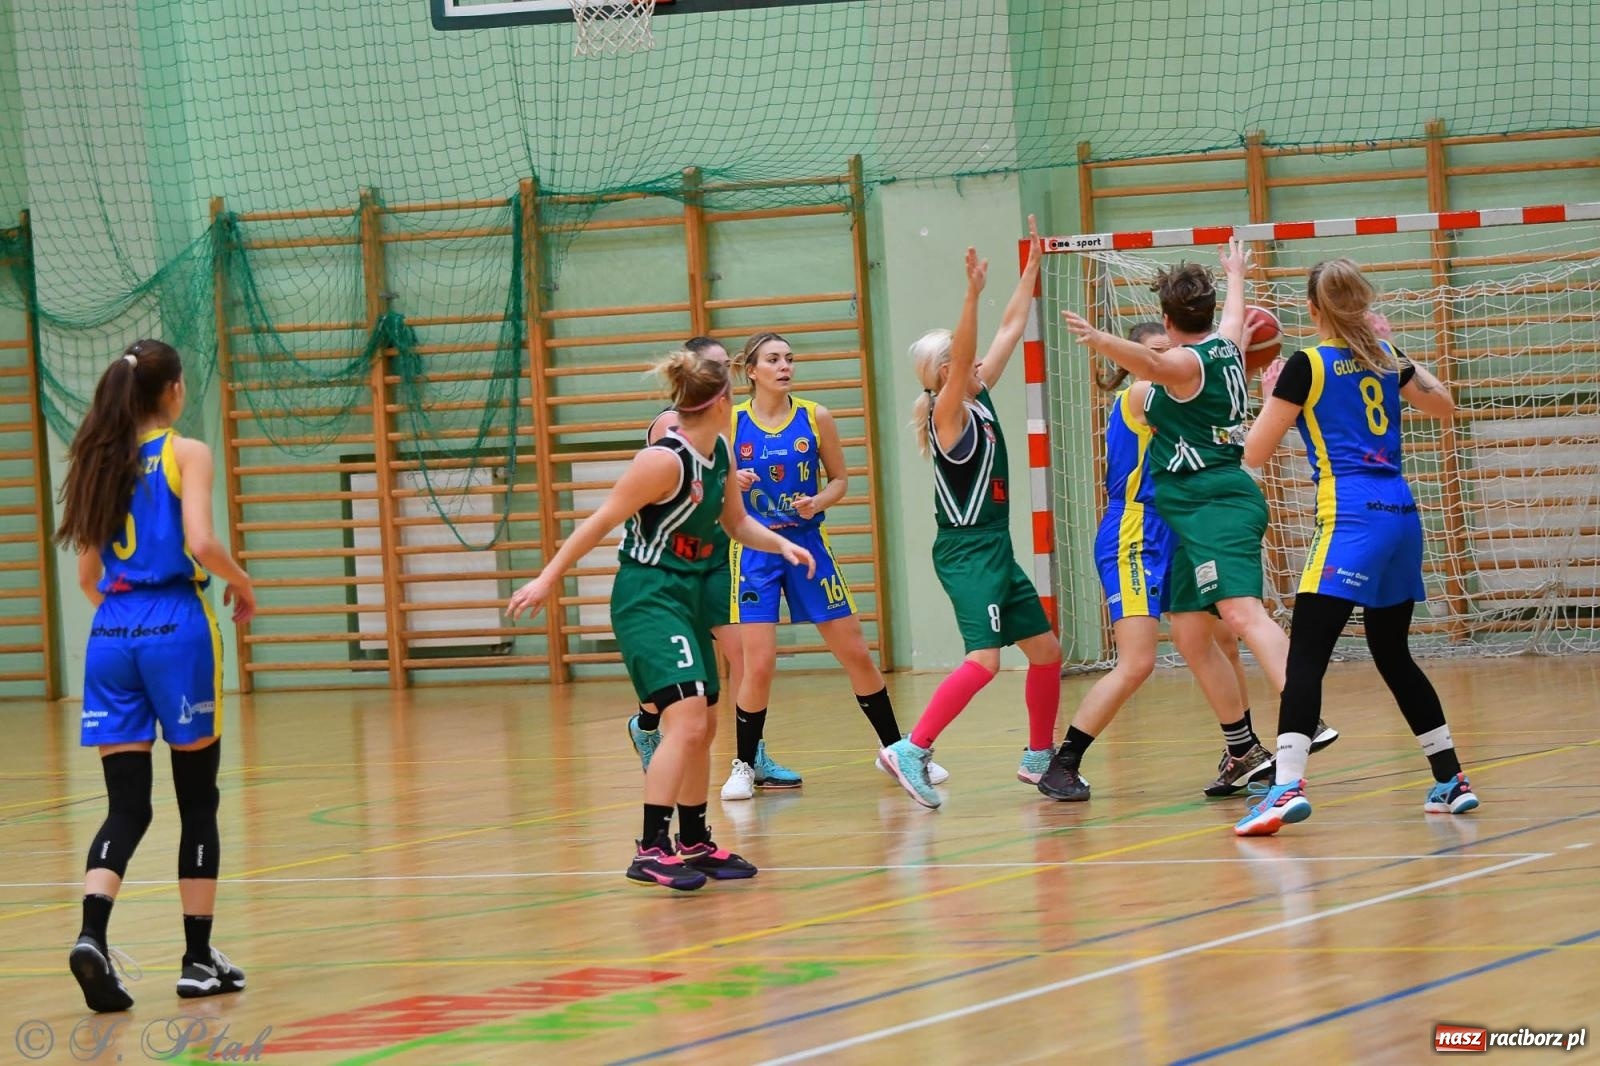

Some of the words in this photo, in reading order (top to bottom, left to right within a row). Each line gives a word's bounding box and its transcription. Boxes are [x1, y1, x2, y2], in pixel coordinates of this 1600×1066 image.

[1359, 376, 1389, 436] 8
[797, 461, 810, 482] 16
[820, 574, 844, 604] 16
[987, 603, 1001, 632] 8
[671, 635, 694, 668] 3
